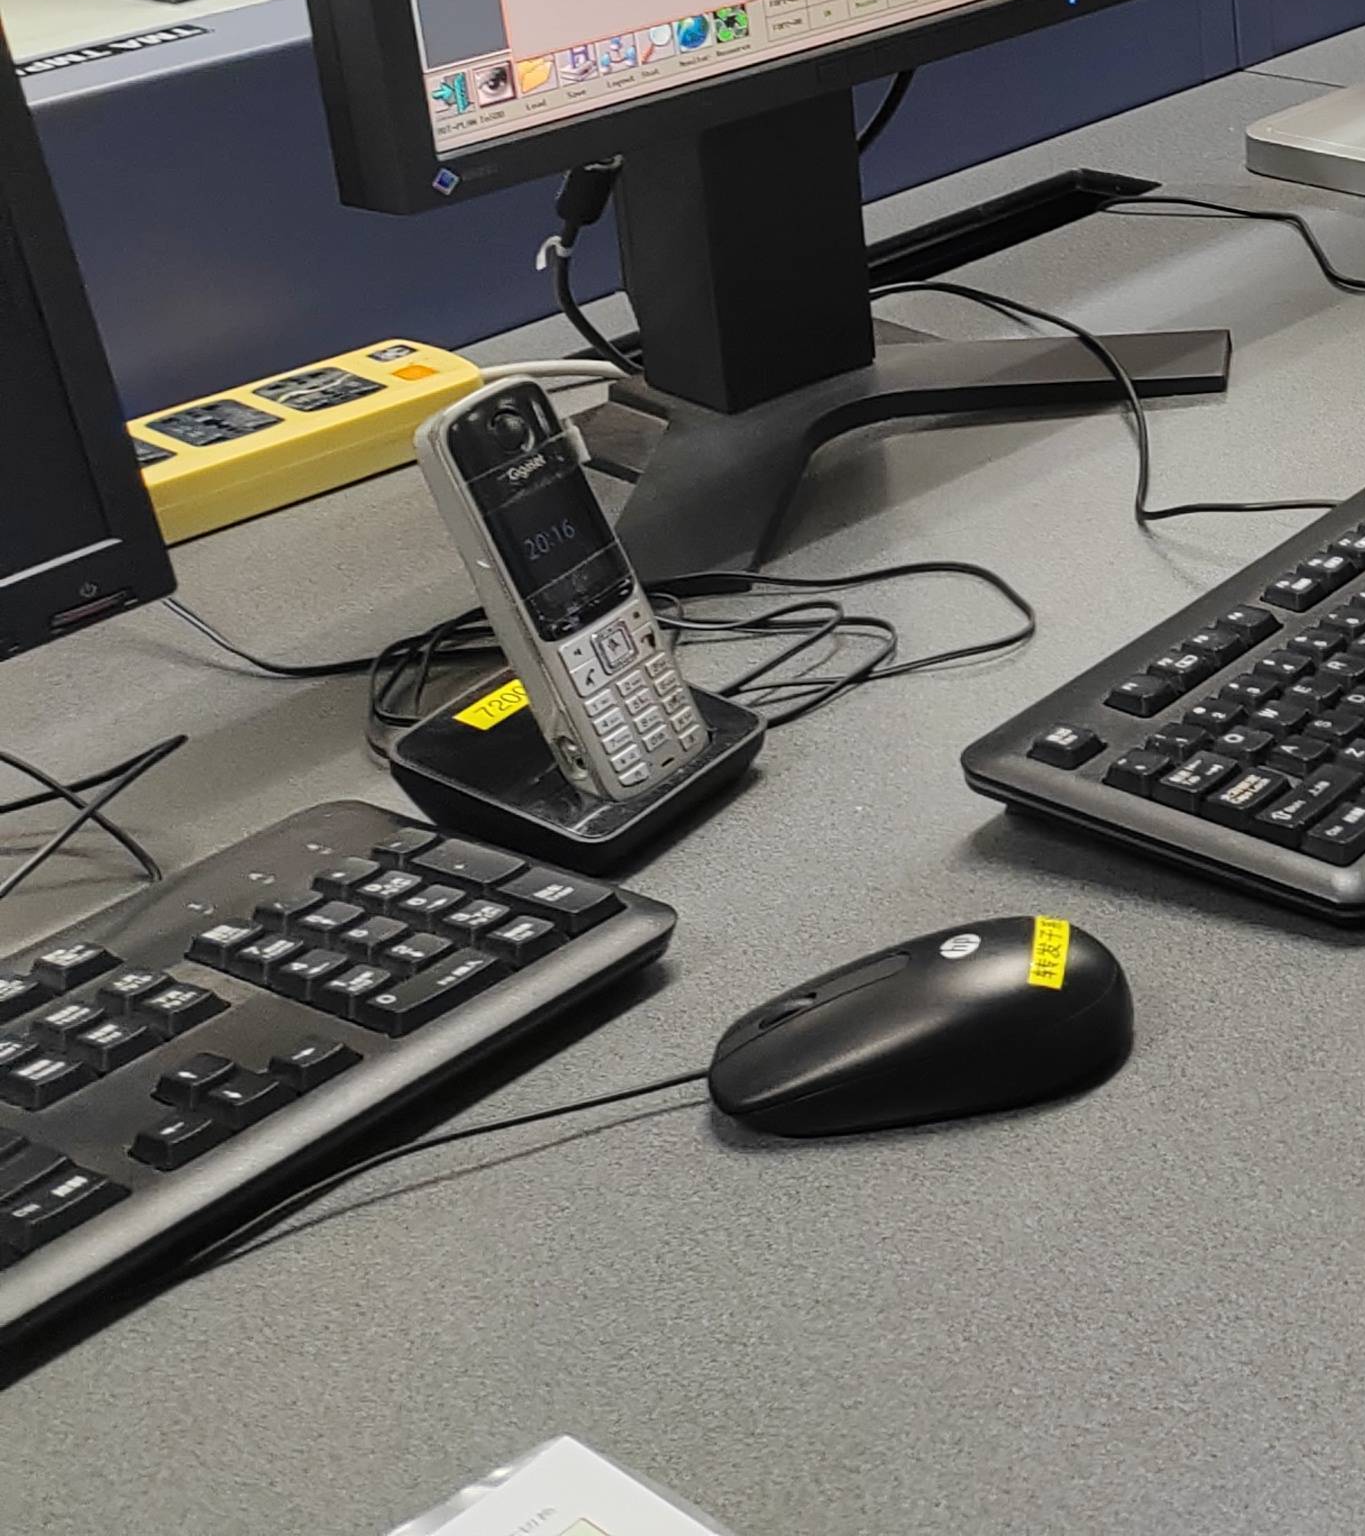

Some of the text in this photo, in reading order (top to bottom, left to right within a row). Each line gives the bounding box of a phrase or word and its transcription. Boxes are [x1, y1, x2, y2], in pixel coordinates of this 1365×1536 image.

[507, 453, 547, 483] Gigaset
[523, 519, 577, 562] 20:16
[941, 934, 981, 959] hp
